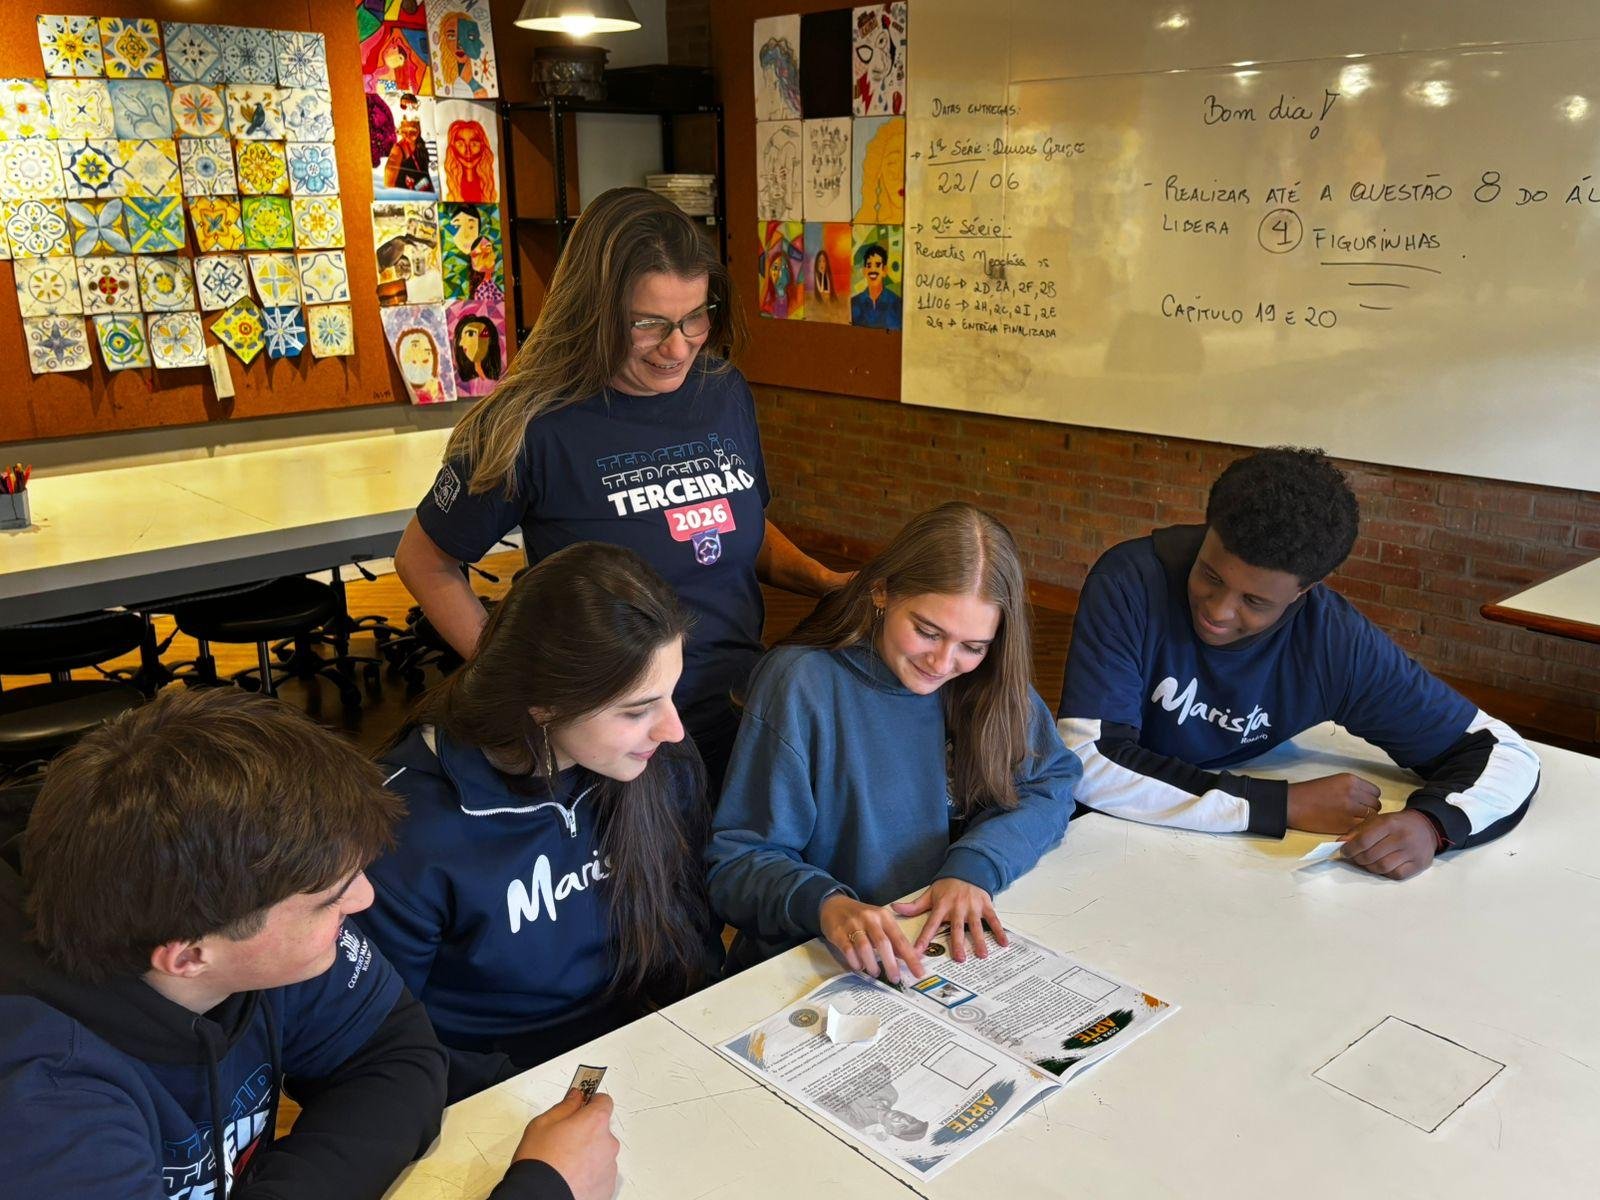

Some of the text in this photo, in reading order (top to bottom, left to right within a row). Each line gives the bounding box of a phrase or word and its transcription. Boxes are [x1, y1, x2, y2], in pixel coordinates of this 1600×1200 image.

[1203, 89, 1340, 139] Bom dia!
[1165, 175, 1250, 204] REALIZAR
[1265, 182, 1301, 203] ATÉ
[1320, 185, 1332, 201] A
[1350, 174, 1452, 202] QUESTÃO
[1474, 171, 1501, 203] 8
[1516, 188, 1548, 205] DO
[1163, 214, 1229, 235] LIBERA
[1313, 228, 1441, 250] FIGURINHAS
[1162, 294, 1337, 328] CAPÍTULO 19 E 20
[607, 464, 755, 517] TERCEIRÃO
[672, 503, 728, 532] 2026
[1151, 676, 1272, 737] Marista
[507, 850, 612, 933] Mari
[1074, 1017, 1117, 1043] ARTE
[947, 1093, 994, 1134] ARTE
[978, 1105, 998, 1122] COPA
